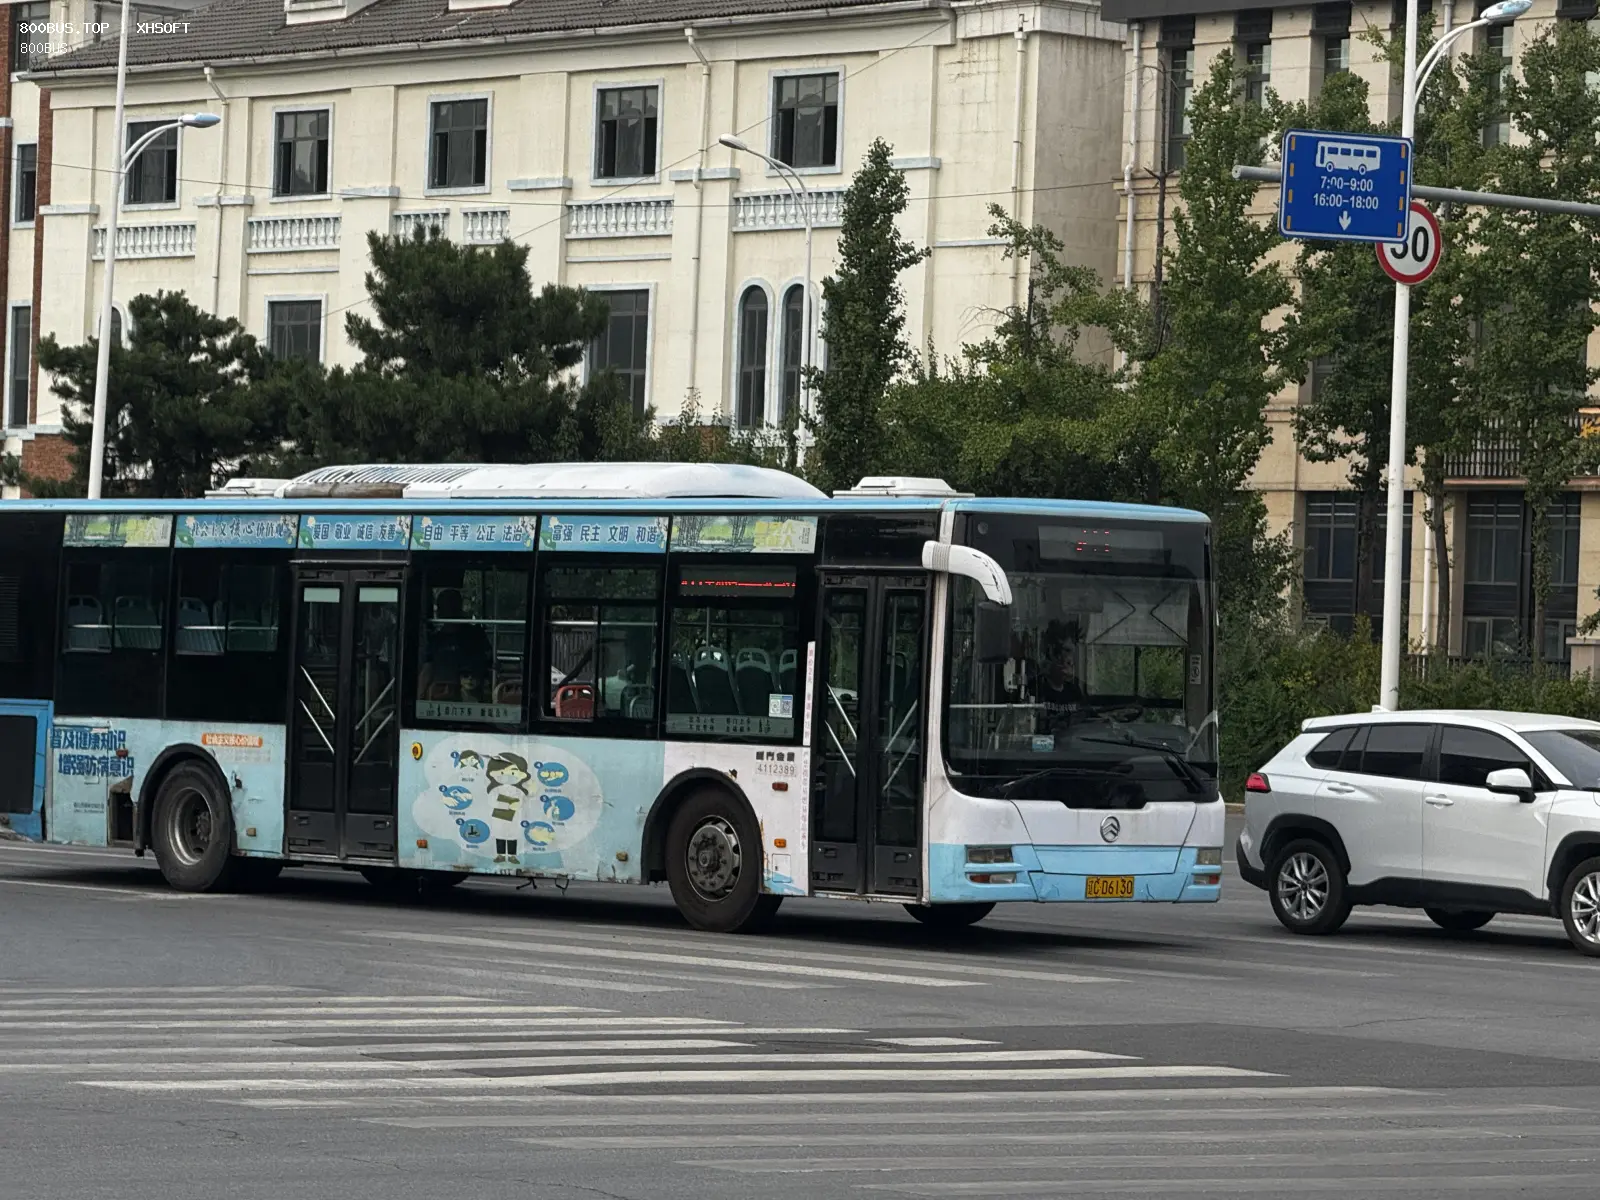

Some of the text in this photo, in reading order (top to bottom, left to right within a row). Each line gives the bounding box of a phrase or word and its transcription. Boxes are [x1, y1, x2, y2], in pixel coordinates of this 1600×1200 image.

[1313, 193, 1379, 209] 16:00-18:00
[313, 523, 396, 541] 爱国 敬业 诚信 友善
[424, 524, 523, 542] 自由 平等 公正 法治
[552, 524, 657, 543] 富强 民主 文明 和谐
[50, 729, 126, 750] 普及健康知识
[757, 763, 795, 776] 4112389
